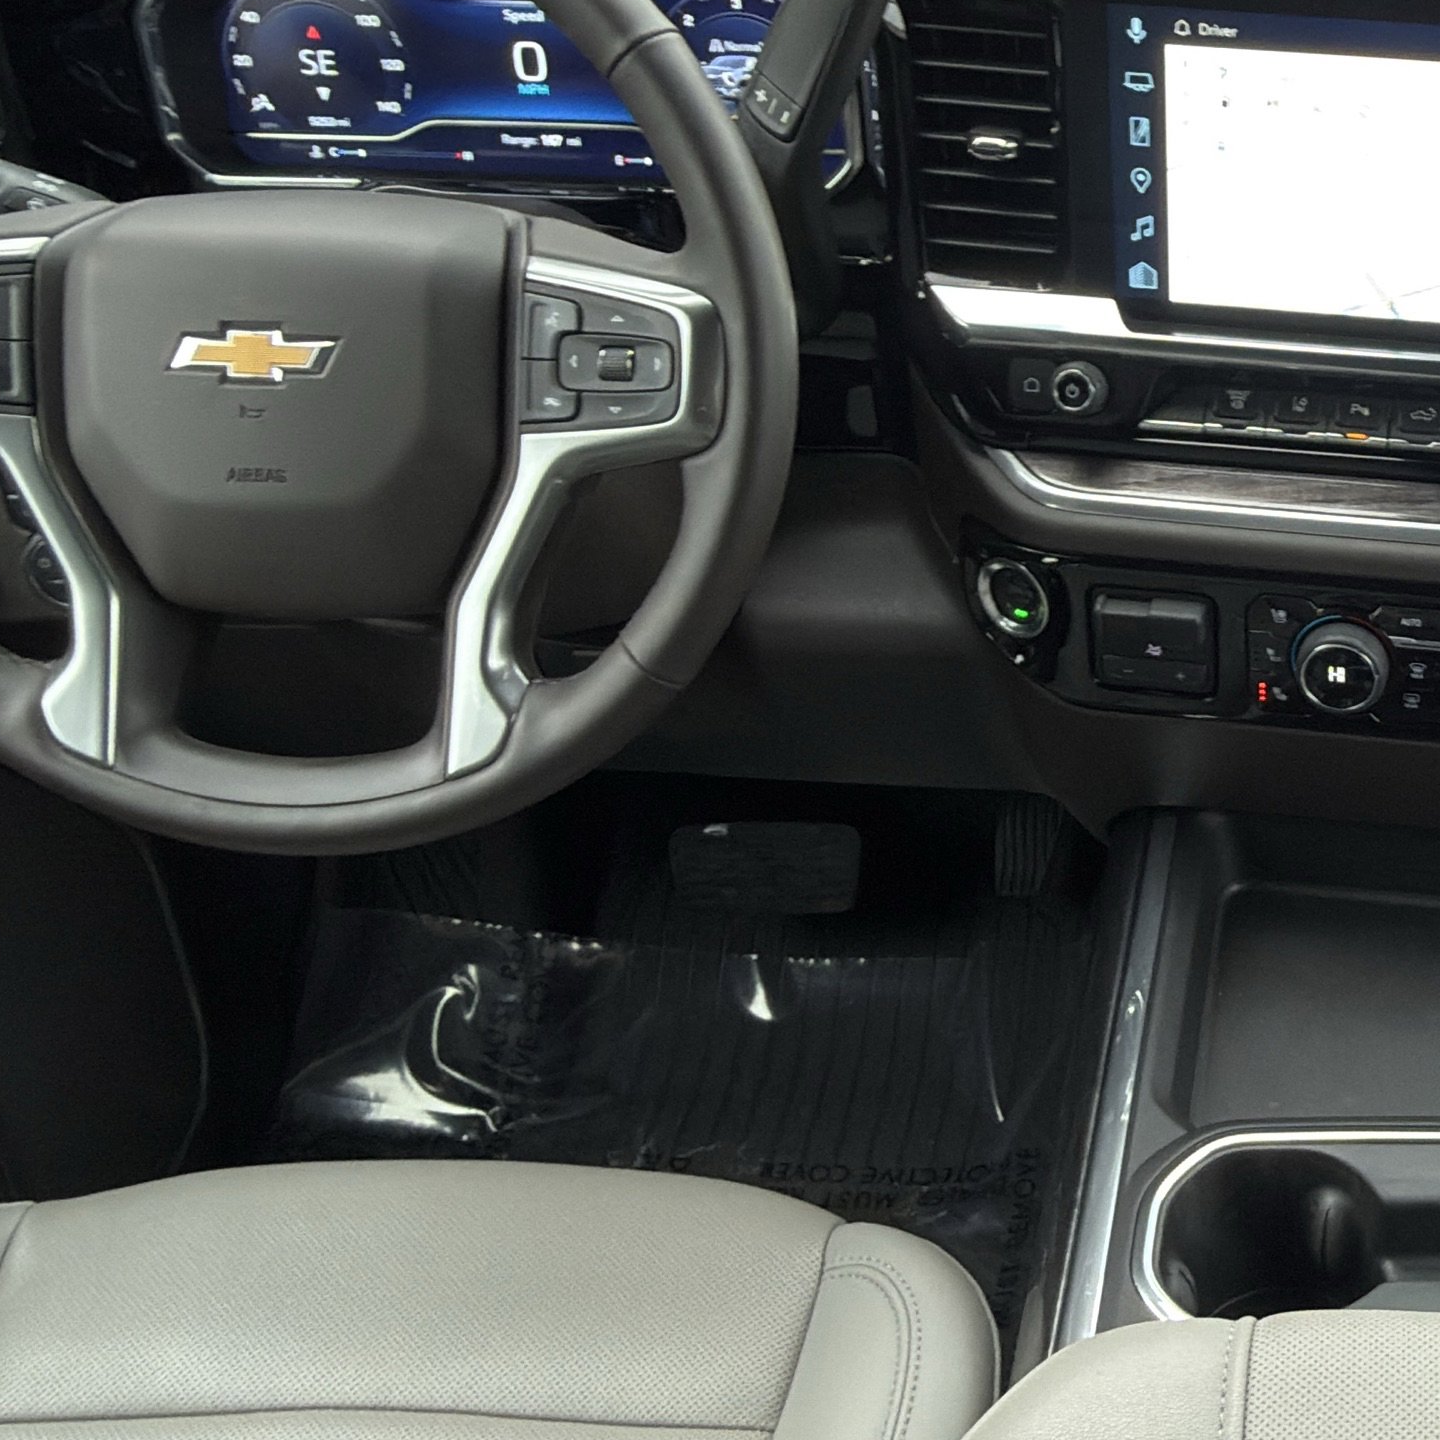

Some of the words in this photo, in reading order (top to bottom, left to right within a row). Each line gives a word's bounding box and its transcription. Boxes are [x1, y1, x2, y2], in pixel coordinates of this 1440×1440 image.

[501, 8, 546, 25] Speed
[1198, 22, 1238, 38] Driver
[298, 48, 340, 76] SE
[512, 40, 548, 83] 0
[1400, 617, 1423, 628] AUTO
[1327, 665, 1347, 684] HI
